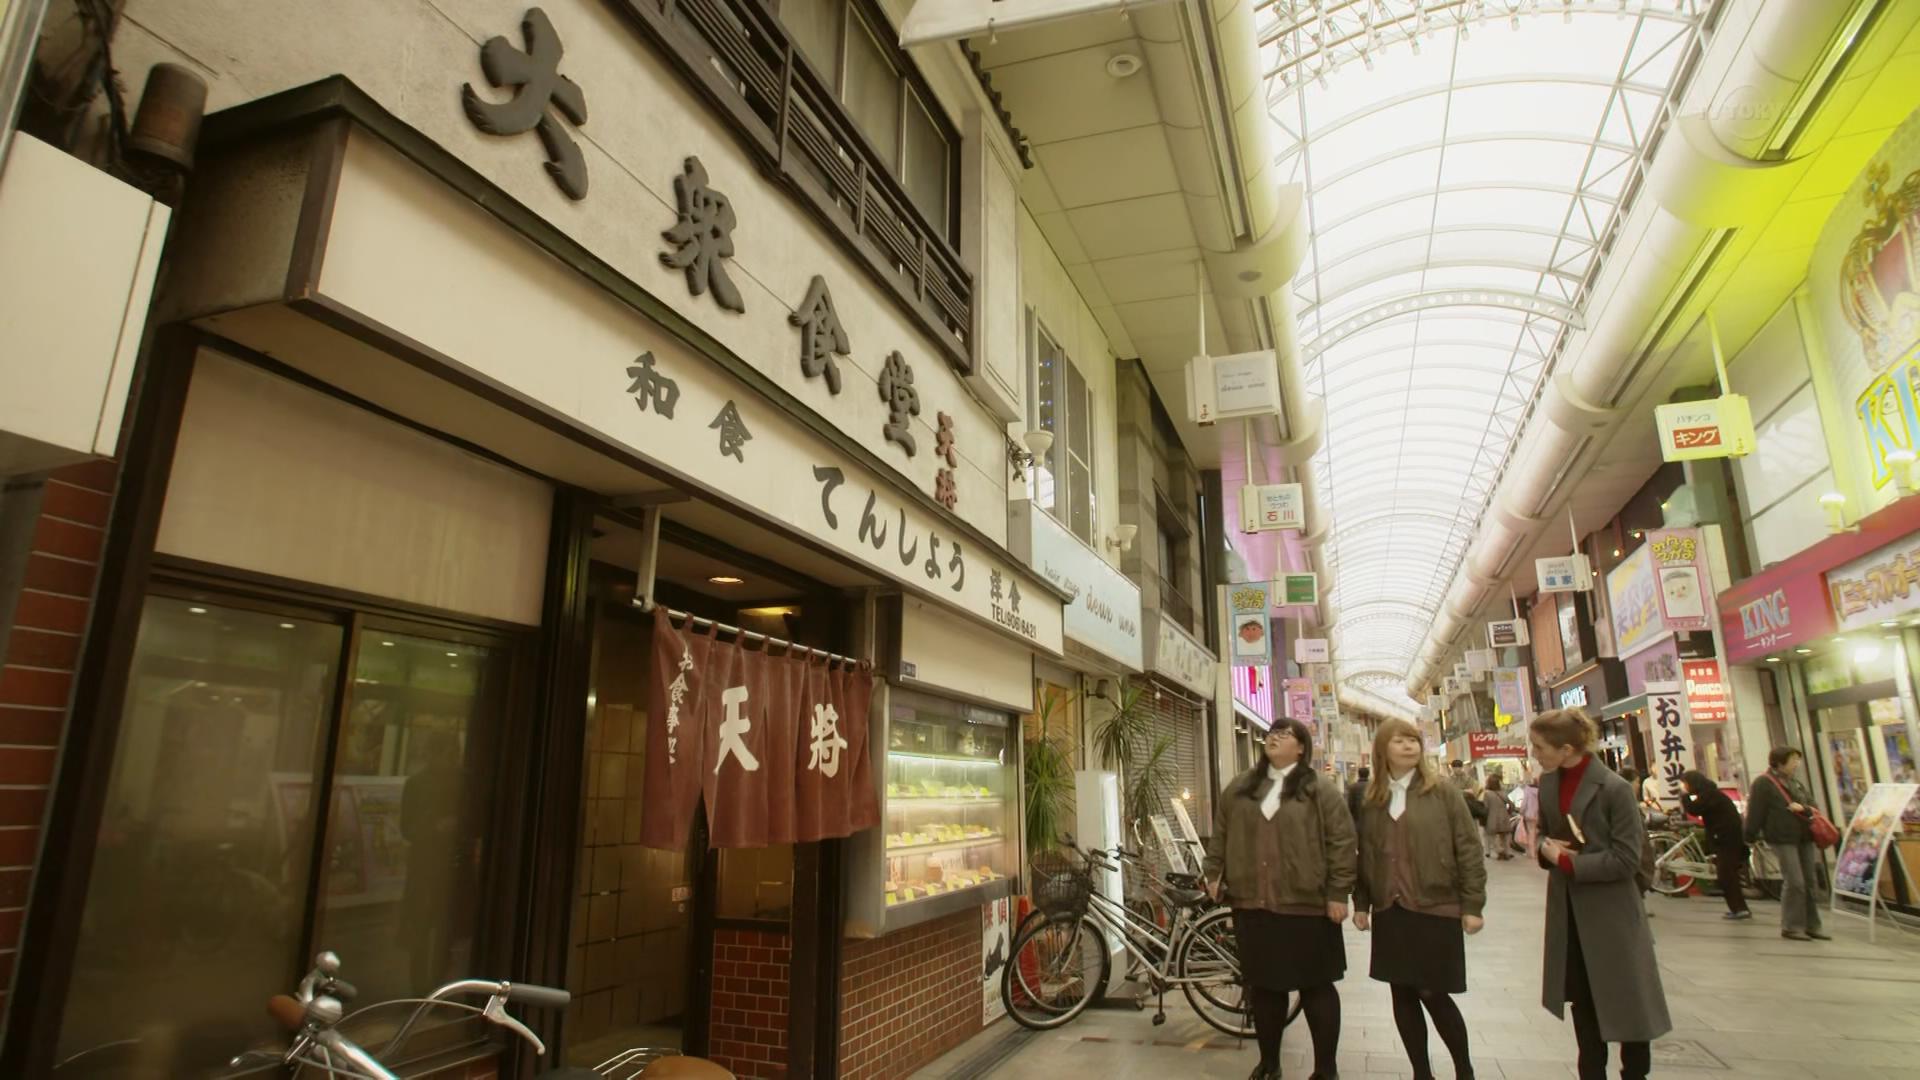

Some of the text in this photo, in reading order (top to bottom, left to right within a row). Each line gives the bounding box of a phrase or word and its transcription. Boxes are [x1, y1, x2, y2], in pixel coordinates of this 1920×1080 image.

[626, 350, 753, 464] 和食
[1675, 428, 1719, 447] キング
[812, 463, 966, 593] てんしょう
[1739, 588, 1792, 640] KING
[1655, 697, 1686, 796] お弁当
